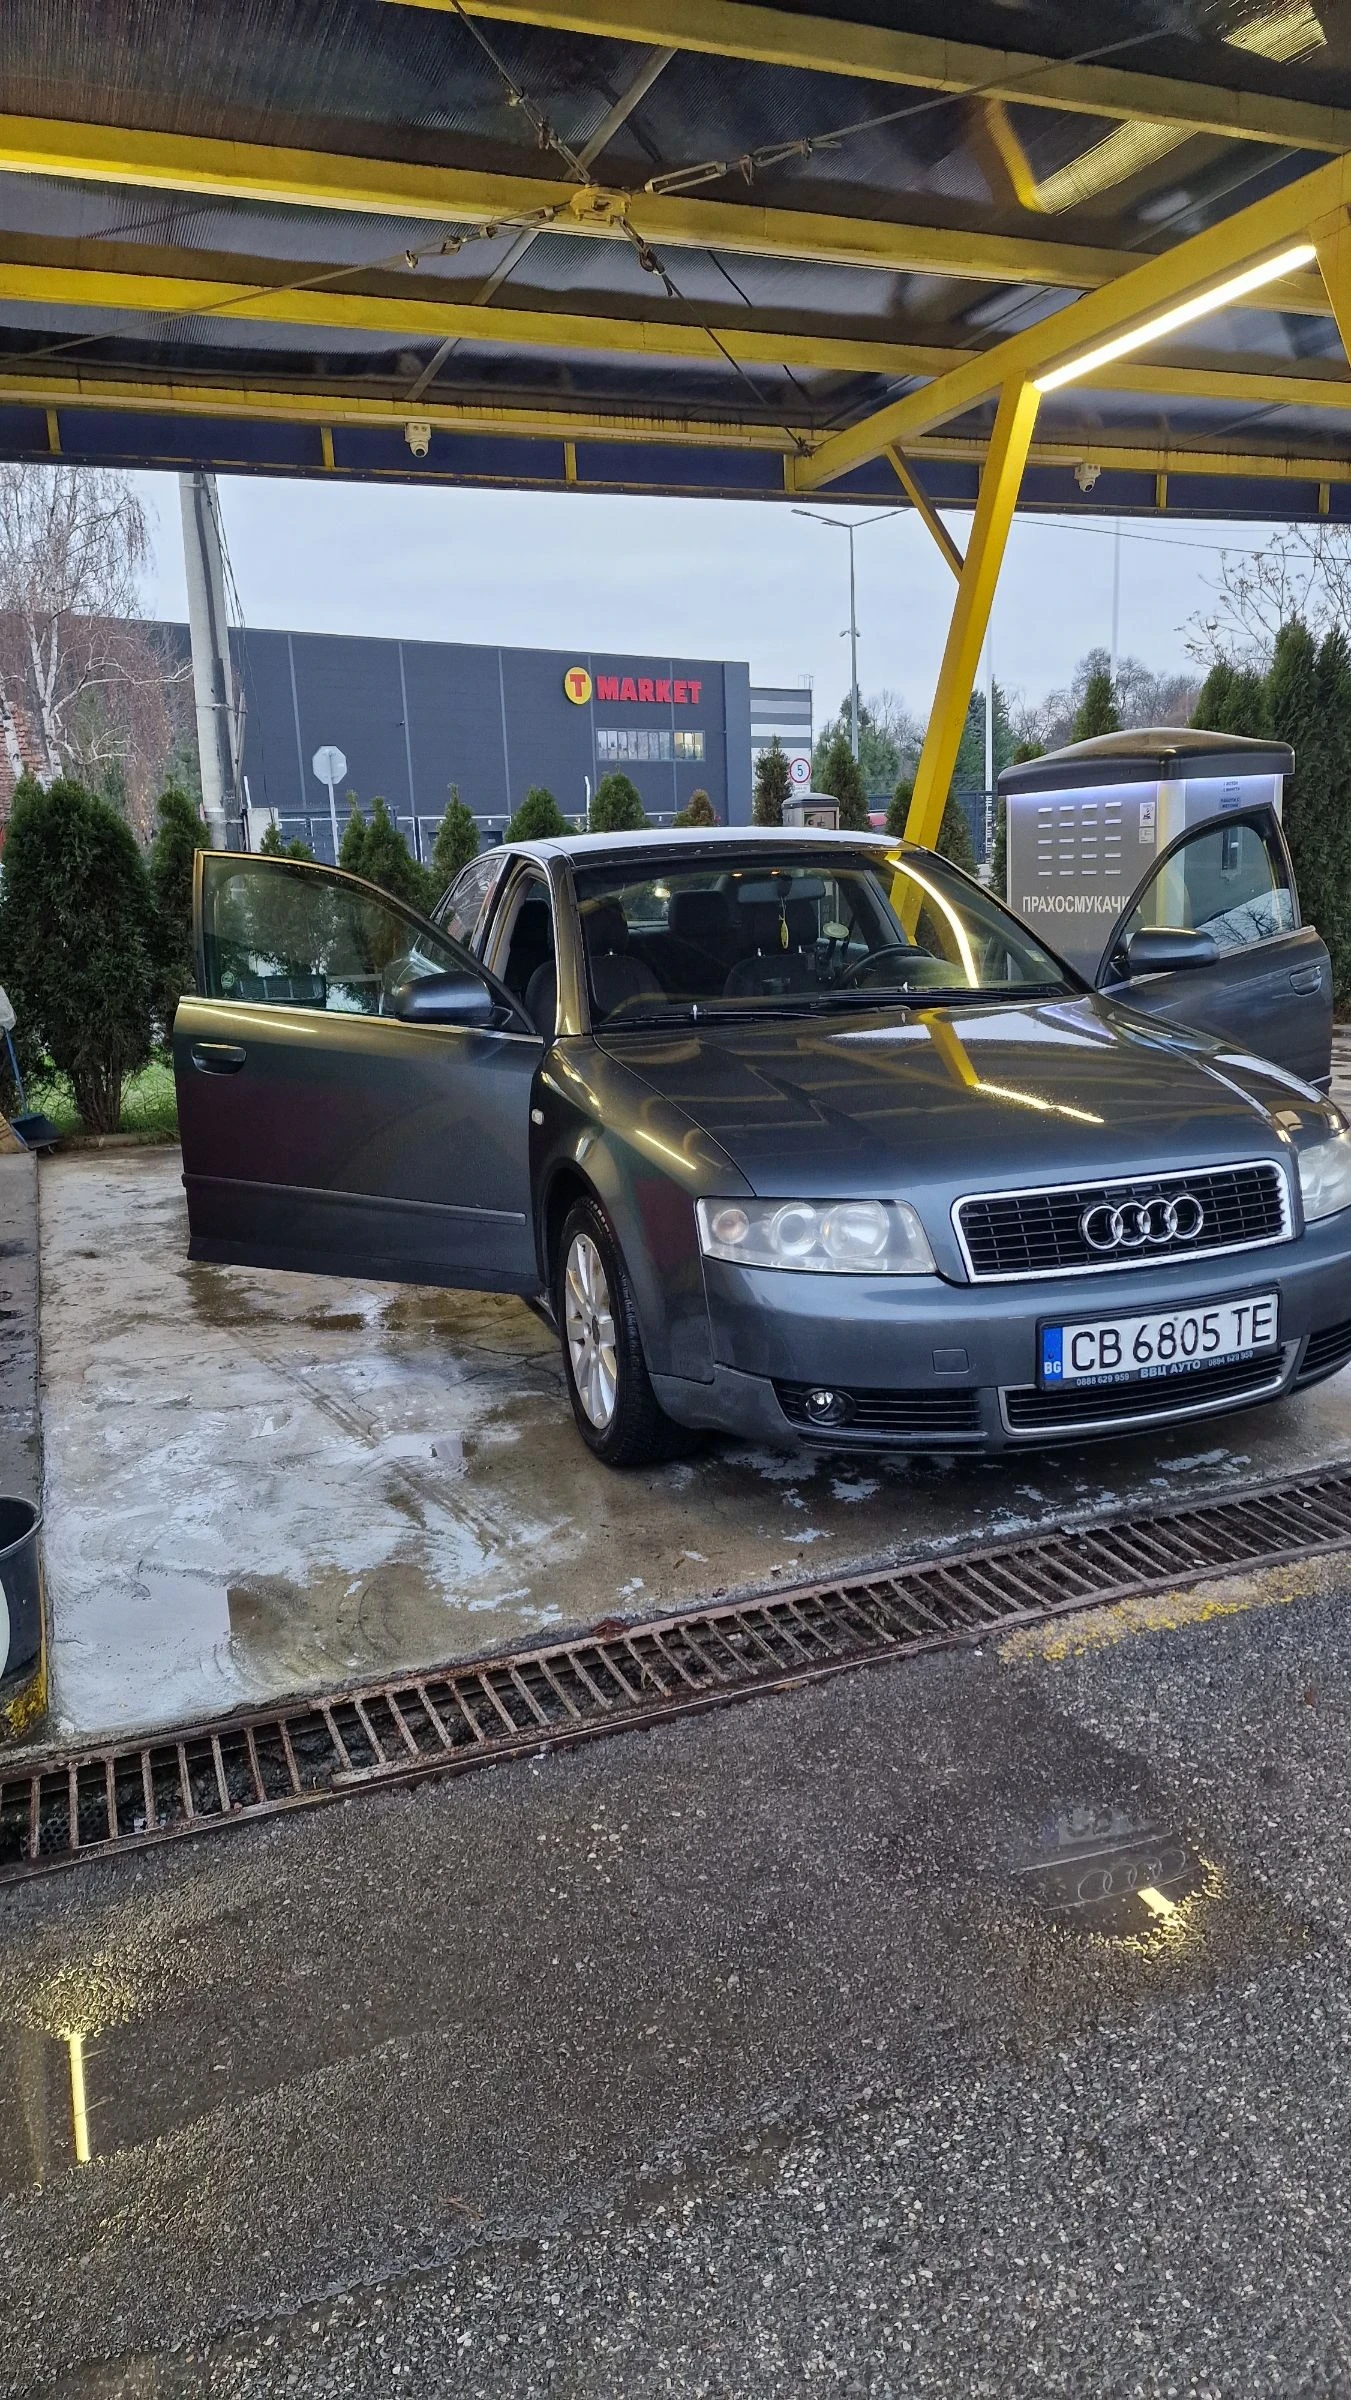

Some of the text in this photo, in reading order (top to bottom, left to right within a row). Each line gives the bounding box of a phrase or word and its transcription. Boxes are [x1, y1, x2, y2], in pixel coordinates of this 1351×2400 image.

[569, 673, 702, 704] T MARKET
[797, 764, 804, 777] 5
[1071, 1302, 1272, 1371] CB 6805 TE
[1043, 1360, 1062, 1375] BG
